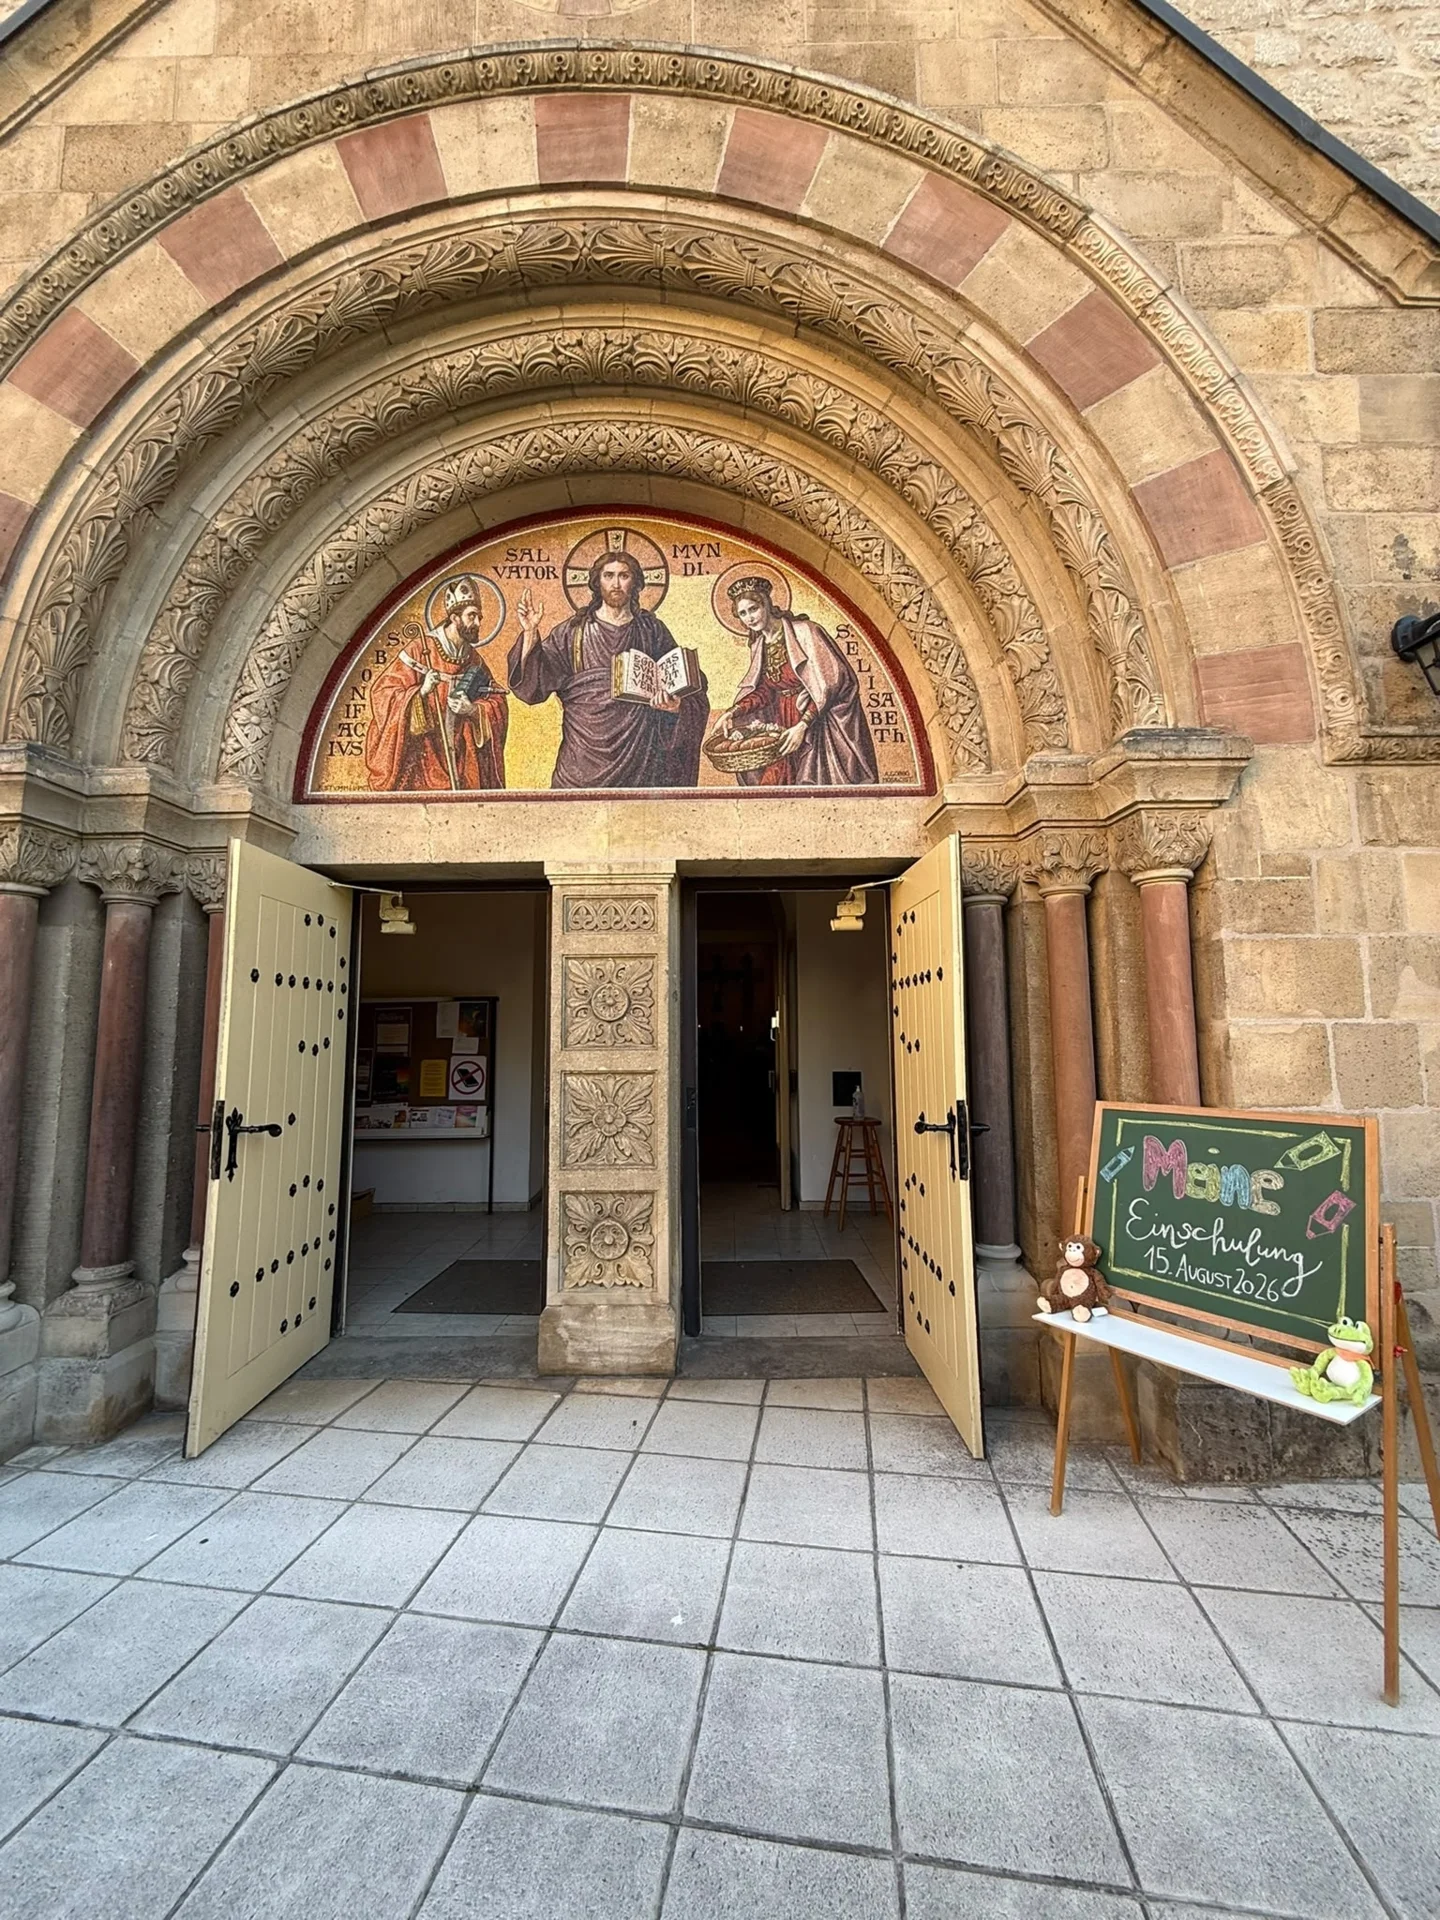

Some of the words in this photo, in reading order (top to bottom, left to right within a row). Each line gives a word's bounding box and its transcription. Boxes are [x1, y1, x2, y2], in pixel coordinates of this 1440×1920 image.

[505, 548, 550, 562] SAL
[672, 542, 721, 558] MVN
[492, 565, 559, 579] VATOR
[633, 654, 654, 669] EGO
[1126, 1198, 1323, 1297] Einschulung
[1144, 1244, 1173, 1275] 15.
[1233, 1268, 1280, 1302] 2026
